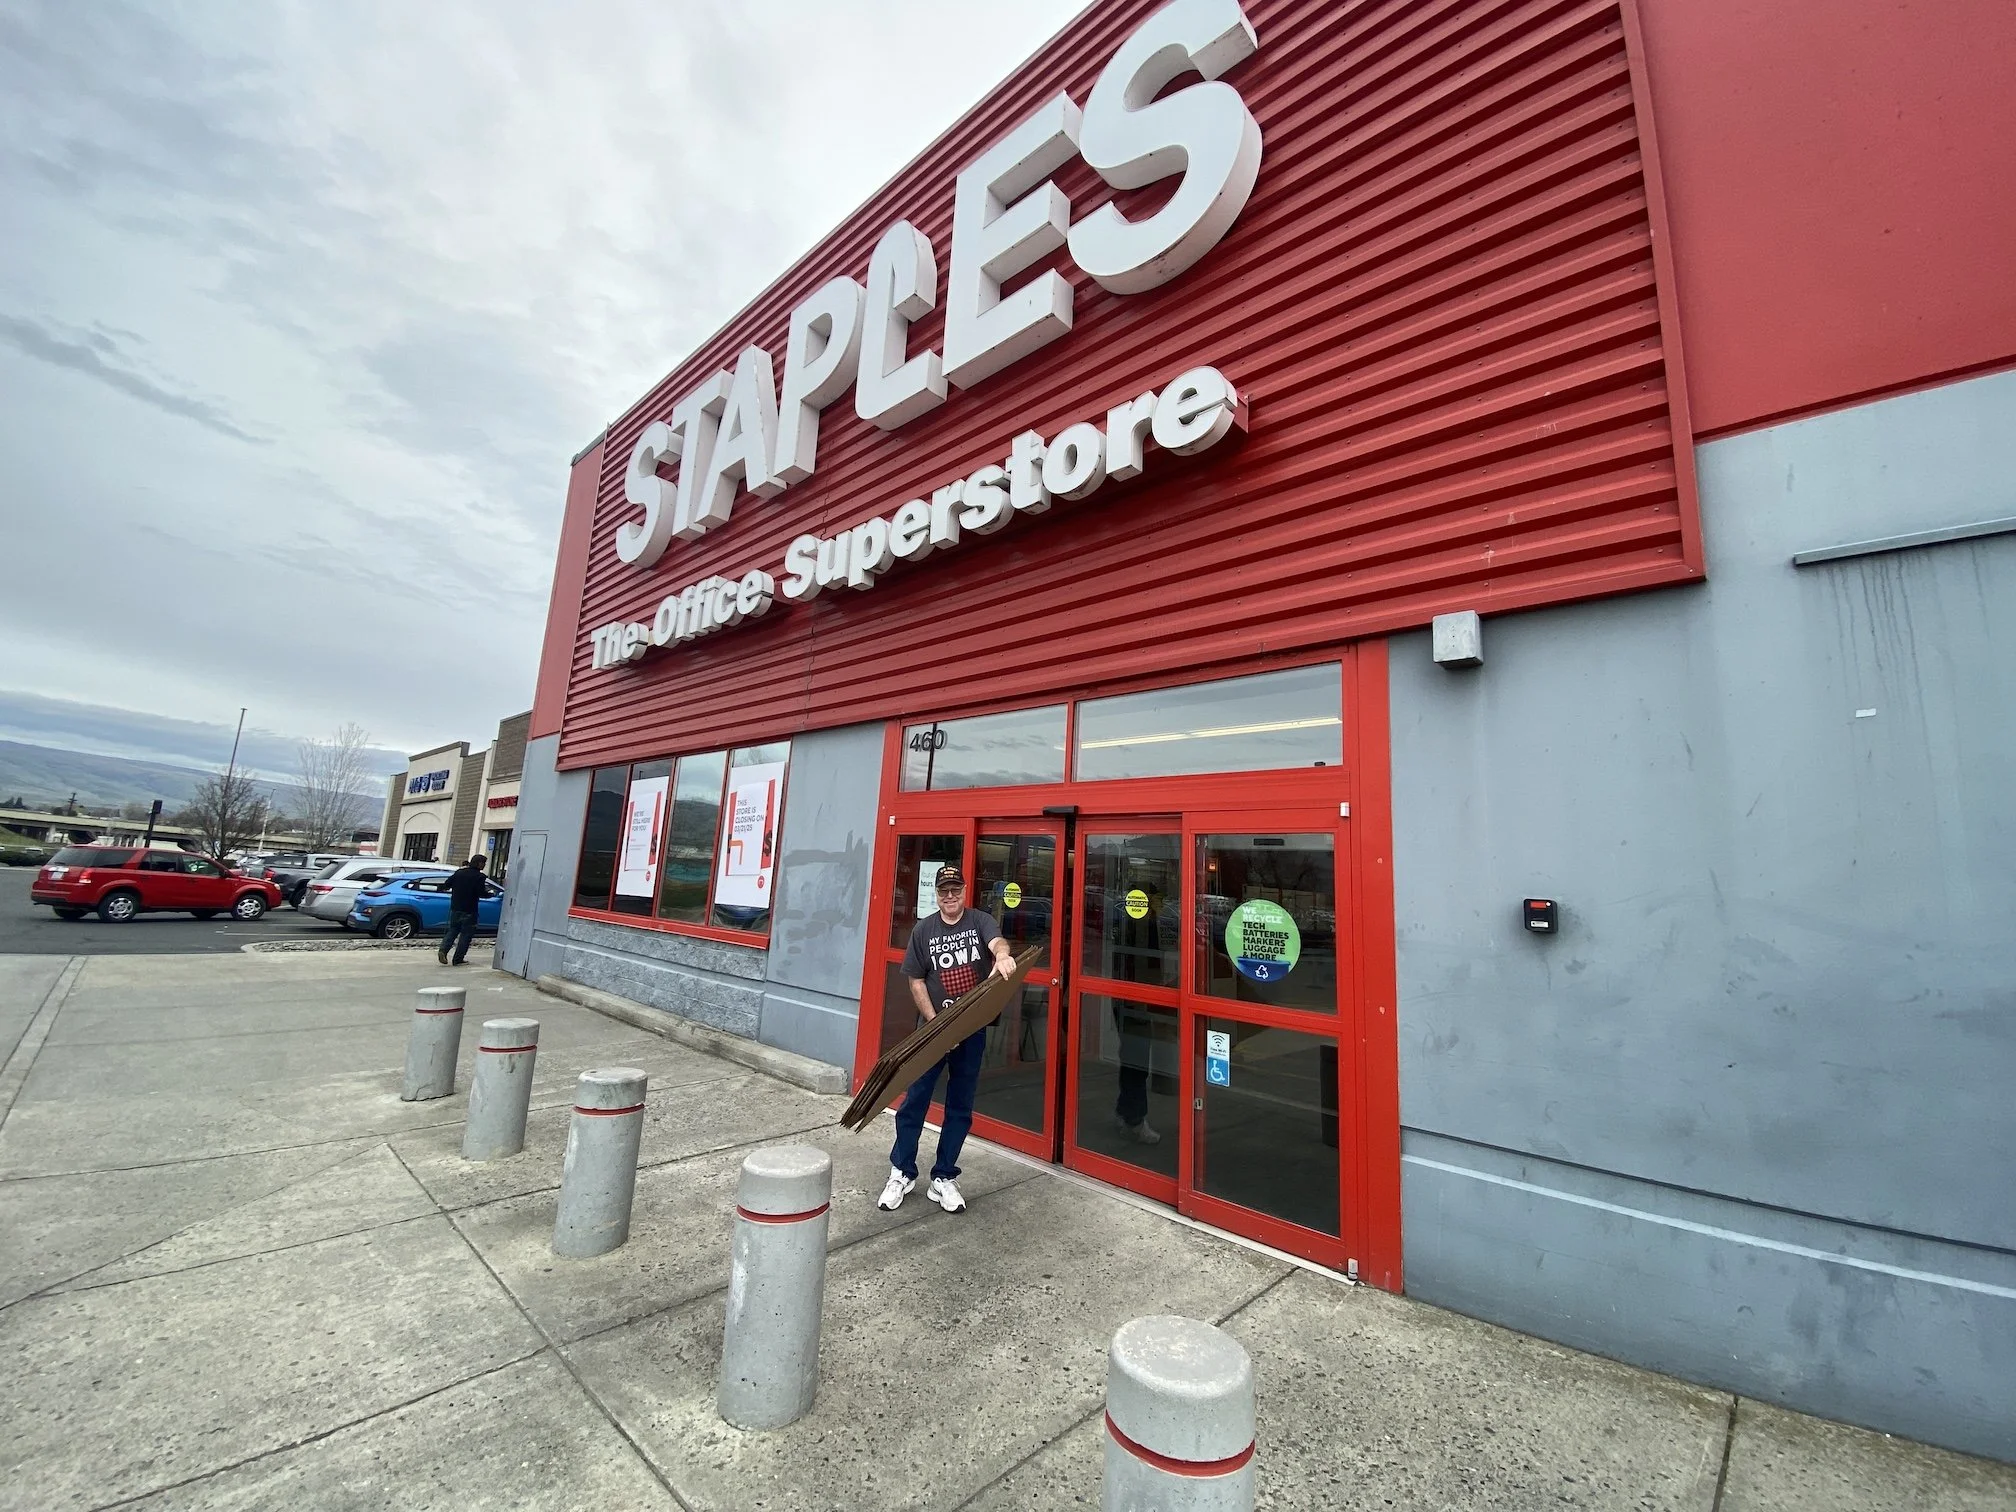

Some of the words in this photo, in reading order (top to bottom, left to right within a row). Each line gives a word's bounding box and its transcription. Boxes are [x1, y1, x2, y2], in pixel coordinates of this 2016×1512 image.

[615, 0, 1262, 568] STAPLES
[590, 621, 648, 670] The
[652, 569, 774, 647] Office
[782, 365, 1238, 601] Superstore
[910, 730, 945, 751] 460
[735, 816, 755, 824] CLOSING
[1242, 906, 1257, 914] WE
[1242, 914, 1283, 924] RECYCLE
[1242, 921, 1266, 930] TECH
[929, 937, 940, 946] MY
[942, 929, 977, 943] FAVORITE
[1242, 929, 1289, 940] BATTERIES
[929, 939, 965, 955] PEOPLE
[969, 936, 979, 946] IN
[1243, 937, 1286, 947] MARKERS
[1243, 944, 1286, 955] LUGGAGE
[931, 946, 981, 971] IOWA
[1242, 951, 1249, 959] &
[1250, 952, 1276, 961] MORE
